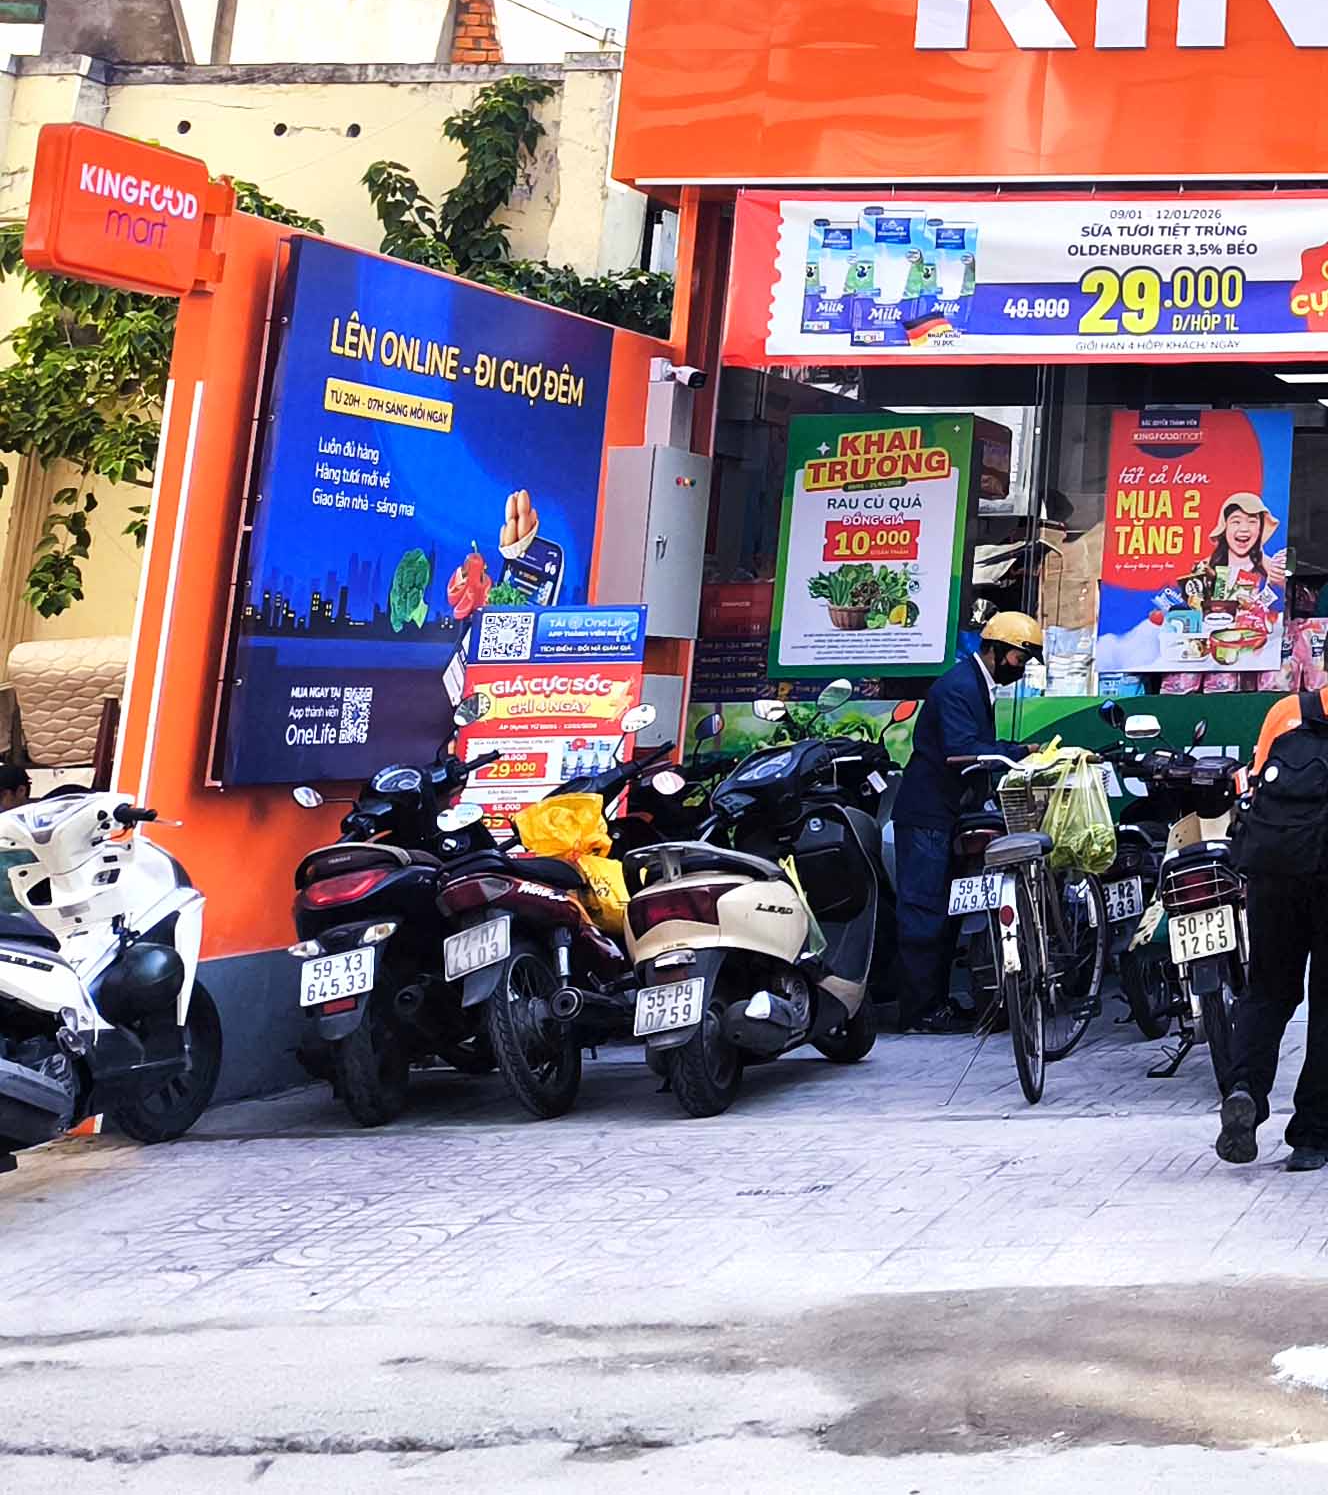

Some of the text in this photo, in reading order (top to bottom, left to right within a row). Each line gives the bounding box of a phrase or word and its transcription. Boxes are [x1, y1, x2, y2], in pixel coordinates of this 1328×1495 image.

[80, 162, 198, 220] KINGFOOD
[1156, 208, 1222, 221] 12/01/2026
[104, 208, 168, 249] mart
[1080, 218, 1248, 242] SỮA TƯƠI TIỆT TRÙNG
[1067, 238, 1258, 258] OLDENBURGER 3,5% BÉO
[816, 301, 845, 314] Milk
[931, 301, 961, 314] Milk
[1078, 266, 1246, 334] 29.000
[868, 307, 903, 321] Milk
[1171, 310, 1239, 336] Đ/HỘP 1L
[330, 310, 584, 407] LÊN ONLINE ĐI CHỢ ĐÊM
[318, 436, 341, 456] Luôn
[840, 429, 918, 457] KHAI
[807, 451, 946, 484] TRƯƠNG
[1119, 463, 1211, 485] tất cả kem
[312, 487, 333, 507] Giao
[827, 493, 922, 511] RAU CỦ QUẢ
[1115, 489, 1201, 519] MUA 2
[842, 511, 905, 526] ĐỒNG GIÁ
[833, 529, 911, 556] 10.000
[1114, 518, 1201, 560] TẶNG 1
[290, 686, 308, 698] MUA
[309, 686, 330, 698] NGAY
[490, 674, 614, 700] GIÁ CỰC SỐC
[288, 705, 305, 720] App
[536, 701, 547, 713] 4
[548, 697, 591, 714] NGÀY
[285, 723, 337, 745] OneLife
[487, 762, 537, 779] 29.000
[1177, 910, 1225, 936] 50-P3
[1181, 935, 1229, 956] 1265
[313, 953, 364, 982] 59-X3
[306, 972, 367, 1004] 645.33
[647, 984, 693, 1009] 55-P9
[645, 1004, 692, 1027] 0759
